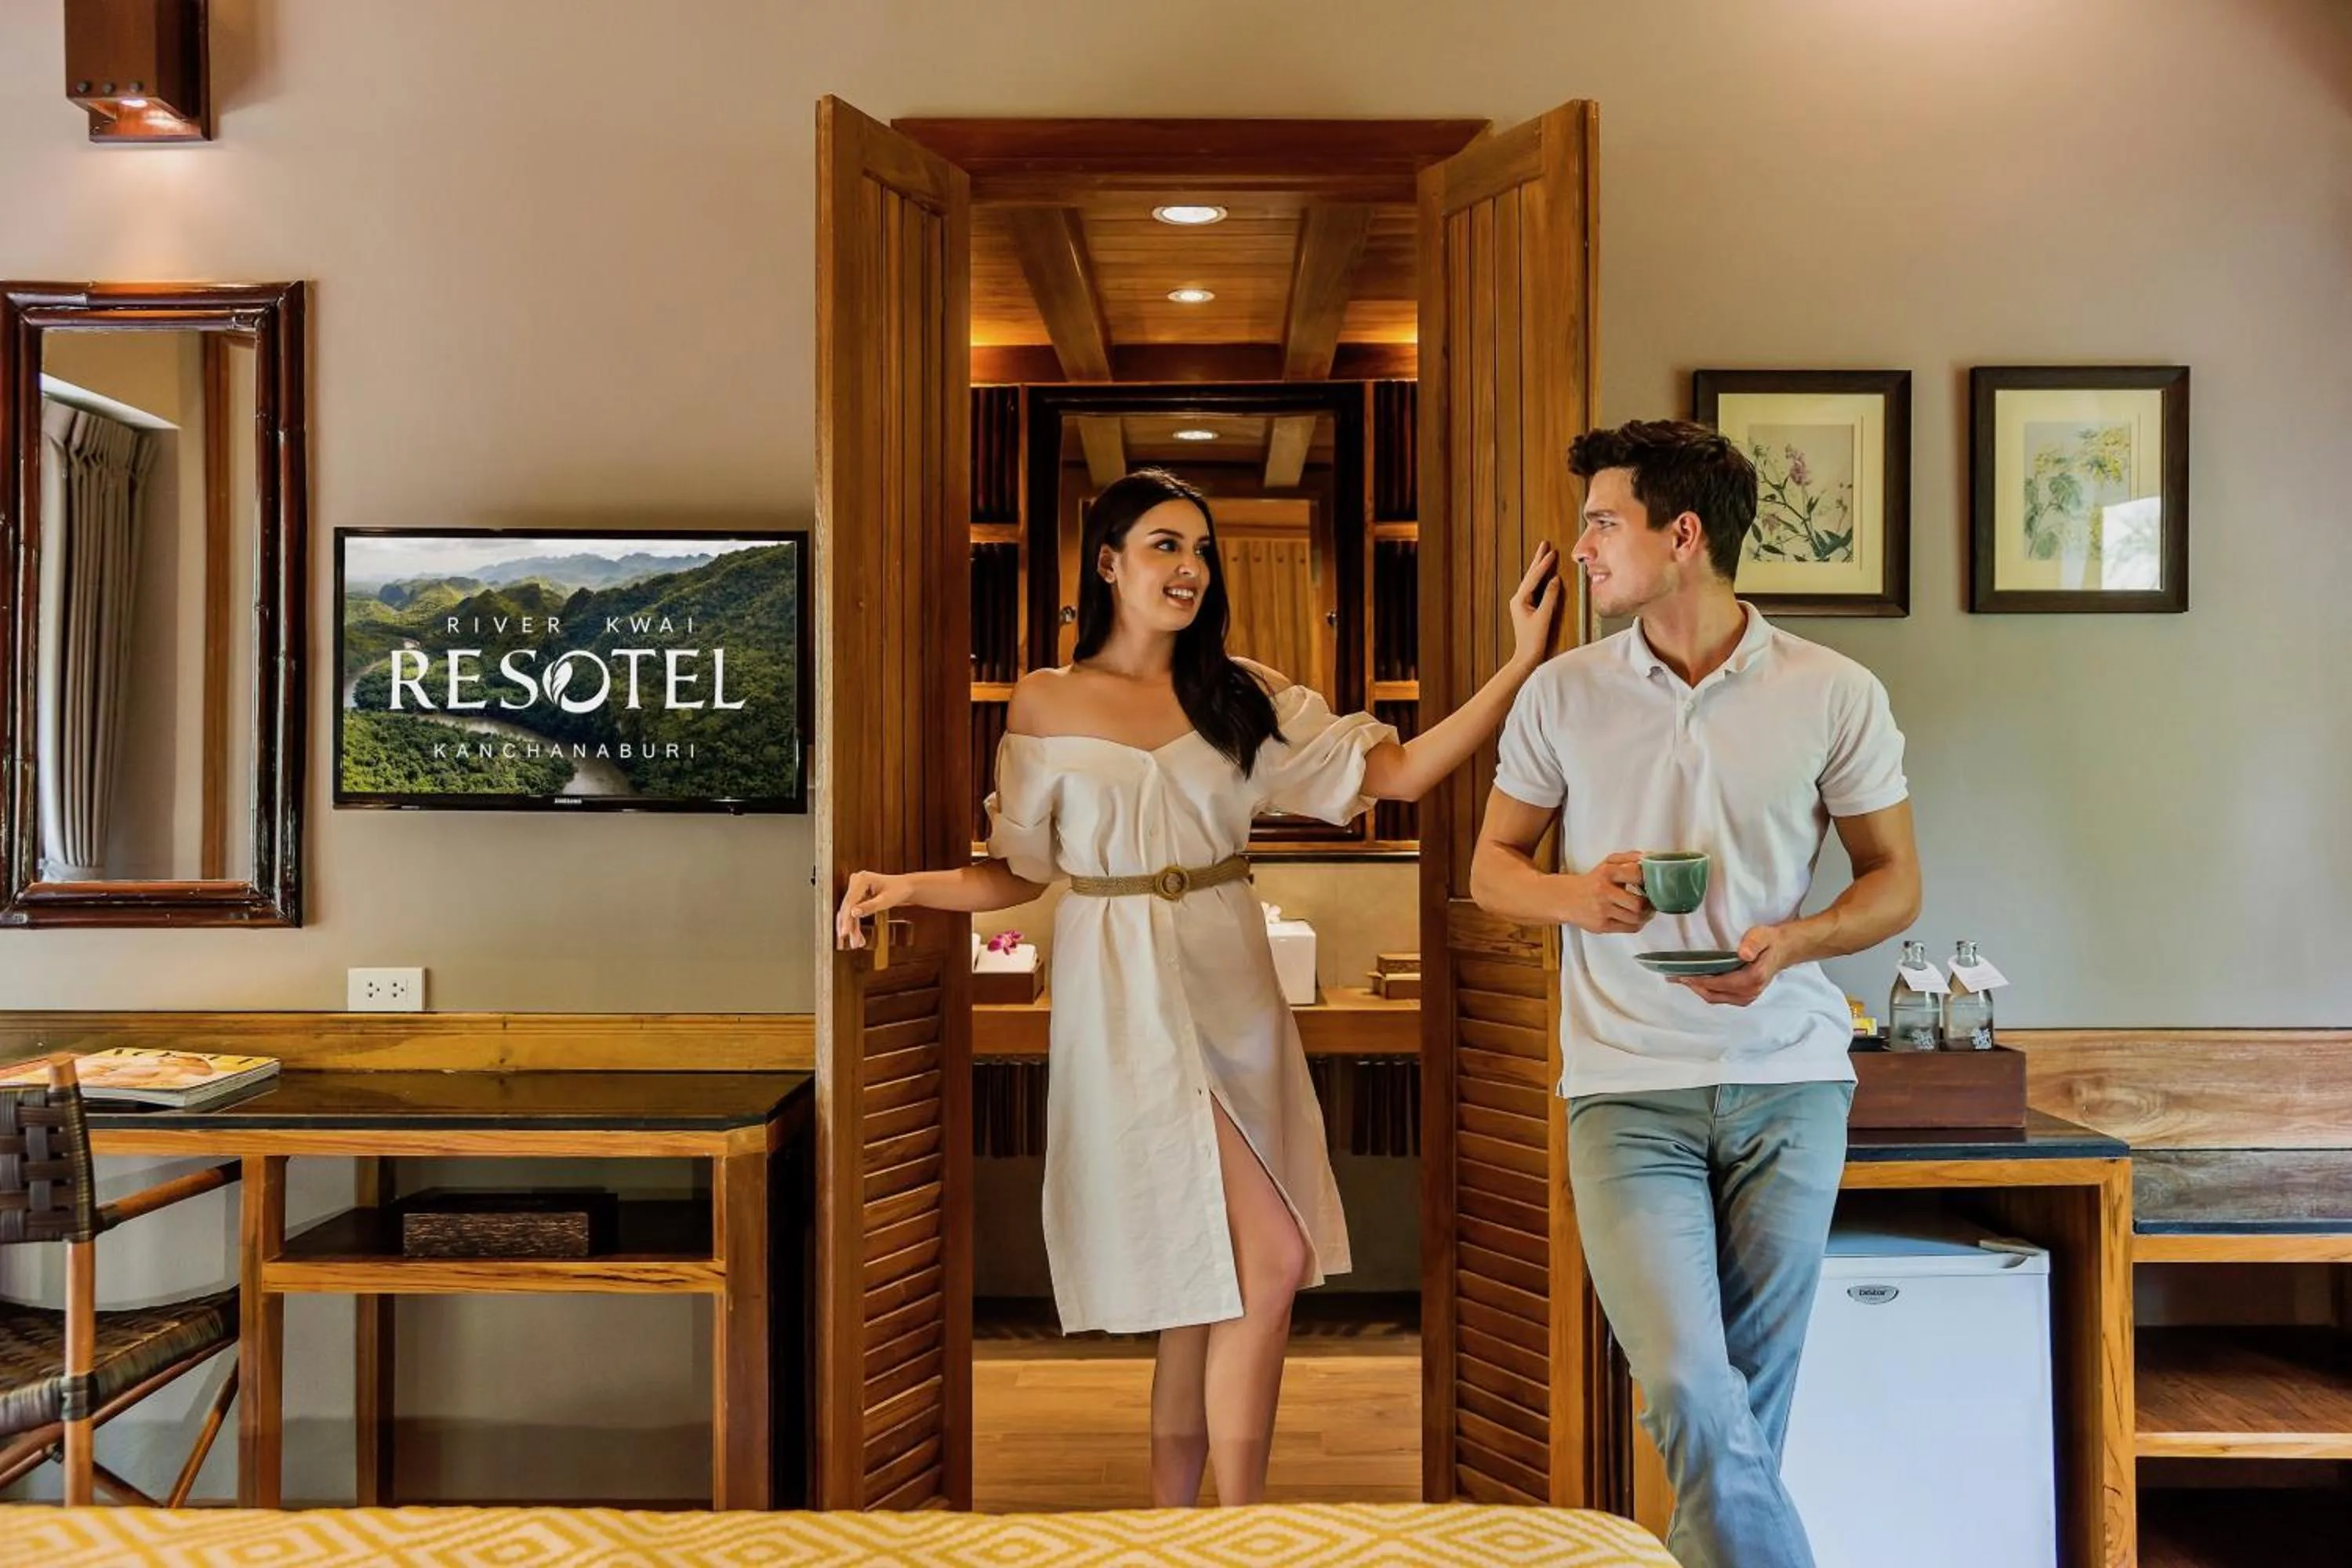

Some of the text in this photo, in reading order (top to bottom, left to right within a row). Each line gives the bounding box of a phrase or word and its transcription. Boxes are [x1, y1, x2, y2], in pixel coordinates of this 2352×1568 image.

[447, 616, 694, 633] RIVER KWAI
[389, 648, 746, 714] RESOTEL
[434, 743, 695, 759] KANCHANABURI
